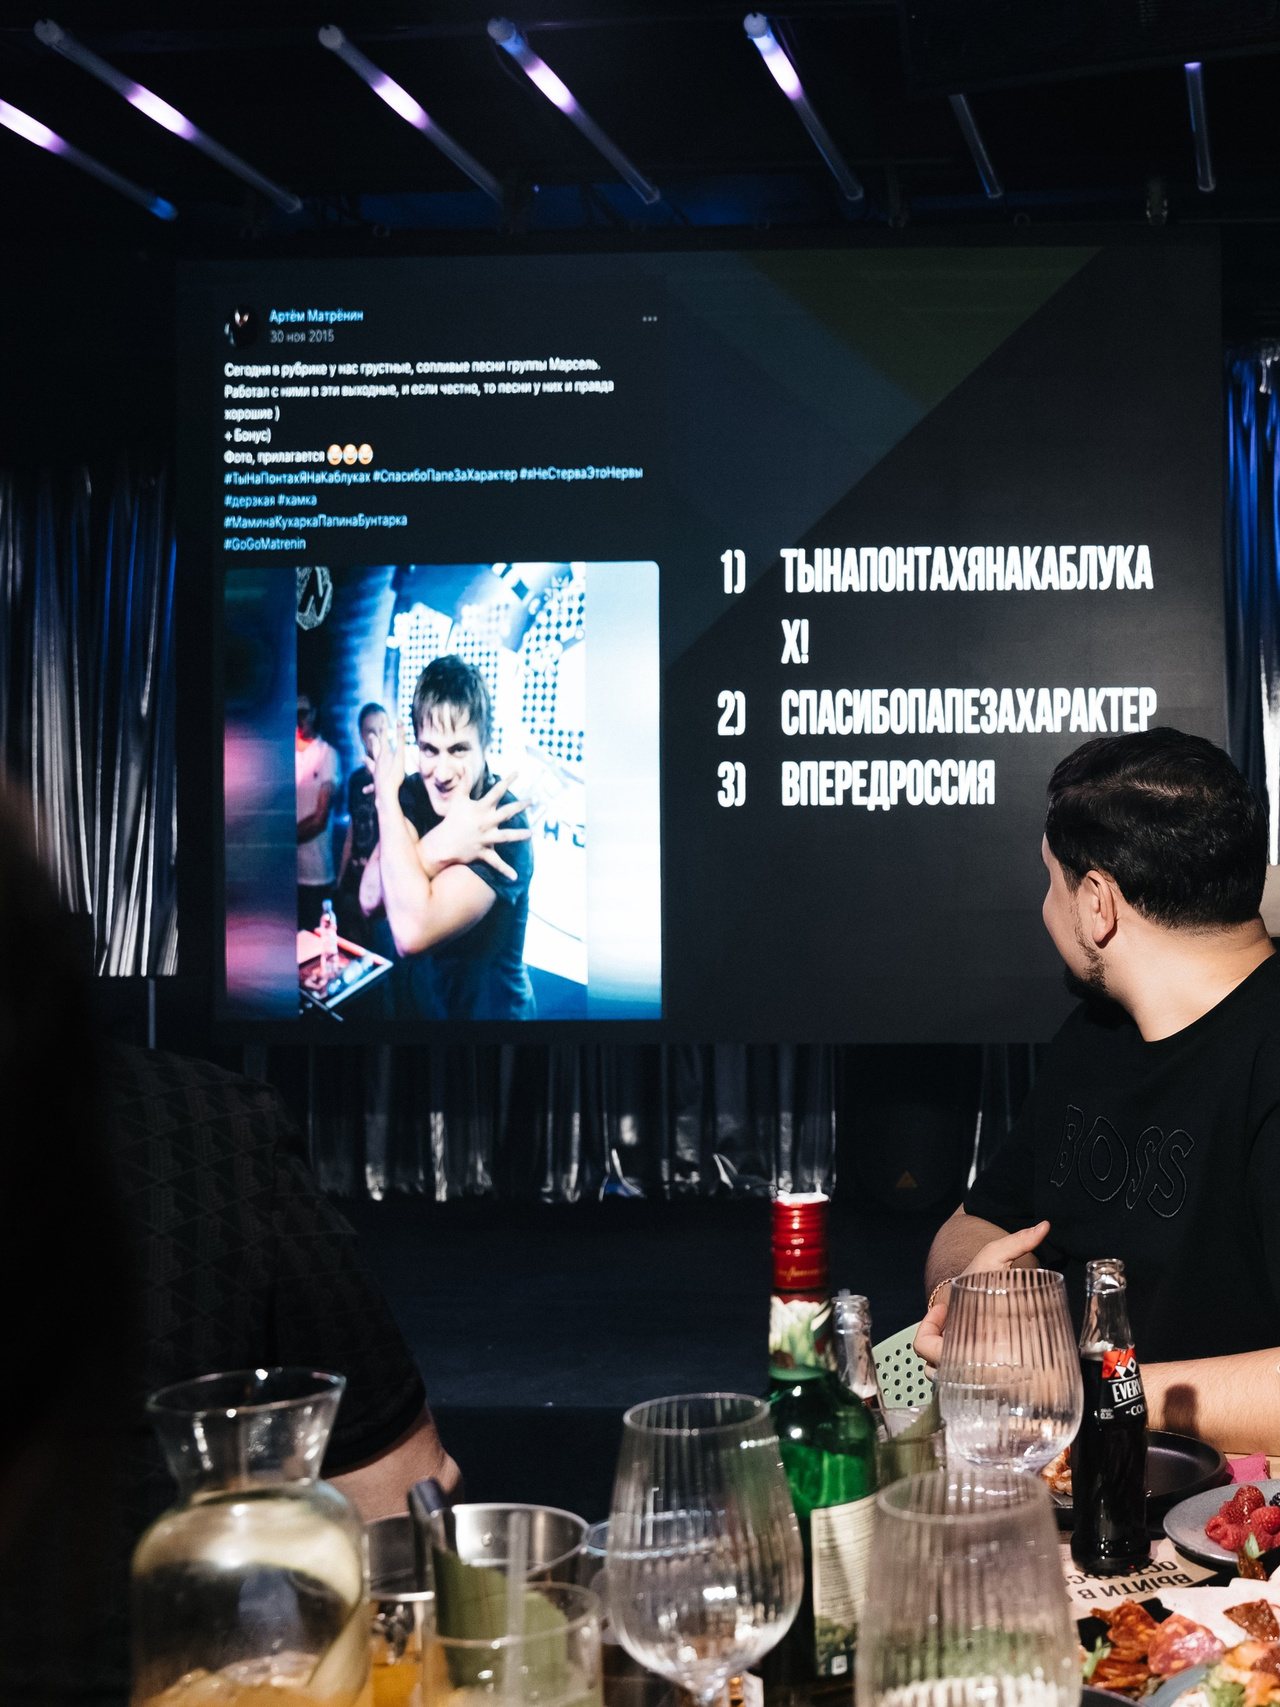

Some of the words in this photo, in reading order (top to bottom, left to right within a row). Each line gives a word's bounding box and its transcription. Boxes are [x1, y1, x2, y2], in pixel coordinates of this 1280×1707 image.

[269, 309, 305, 324] Артём
[307, 309, 363, 323] Матрёнин
[271, 330, 284, 343] 30
[286, 332, 305, 342] ноя
[309, 329, 334, 342] 2015
[224, 363, 271, 378] Сегодня
[272, 365, 280, 376] в
[281, 361, 327, 378] рубрике
[329, 364, 336, 377] у
[338, 363, 358, 375] нас
[416, 361, 470, 373] сопливые
[472, 361, 505, 372] песни
[507, 360, 547, 374] группы
[224, 384, 269, 398] Работал
[271, 386, 279, 398] с
[280, 386, 310, 397] ними
[311, 386, 319, 397] в
[320, 386, 340, 397] эти
[401, 385, 409, 395] и
[411, 384, 438, 395] если
[483, 383, 496, 394] то
[498, 382, 532, 393] песни
[533, 382, 541, 396] у
[542, 382, 563, 392] них
[564, 382, 572, 392] и
[574, 380, 614, 394] правда
[224, 408, 273, 422] хорошие
[257, 451, 325, 465] прилагается
[224, 495, 275, 508] #дерзкая
[277, 494, 317, 506] #хамка
[224, 537, 306, 551] #GoGoMatrenin
[721, 549, 745, 594] 1)
[780, 545, 1154, 593] ТЫНАПОНТАХЯНАКАБЛУКА
[781, 619, 809, 664] Х!
[718, 690, 745, 735] 2)
[781, 687, 1157, 735] СПАСИБОПАПЕЗАХАРАКТЕР
[718, 761, 746, 807] 3)
[782, 759, 995, 811] ВПЕРЕДРОССИЯ
[1049, 1104, 1195, 1218] BOSS
[1100, 1573, 1194, 1597] ВЫЙТИ
